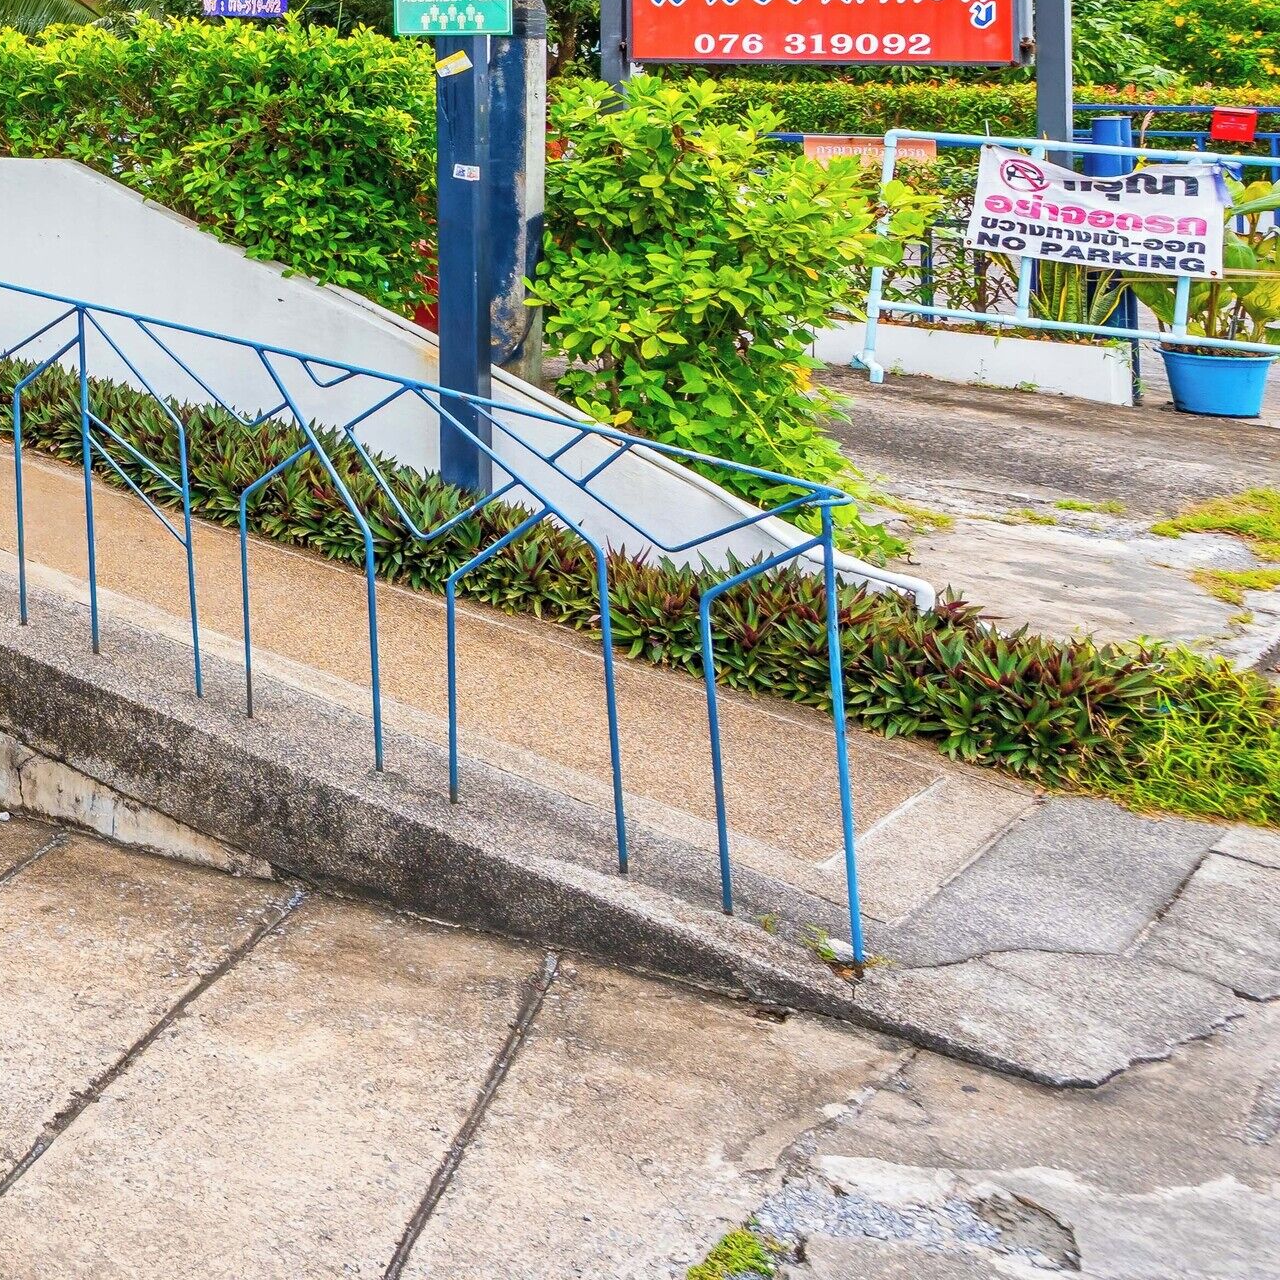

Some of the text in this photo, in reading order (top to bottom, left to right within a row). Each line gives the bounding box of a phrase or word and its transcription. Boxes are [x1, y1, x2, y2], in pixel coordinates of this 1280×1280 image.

[694, 32, 932, 55] 076 319092
[981, 215, 1206, 255] ขวางทางเข้า-ออก
[984, 194, 1208, 237] อย่าจอดรถ
[977, 231, 1205, 273] NO PARKING
